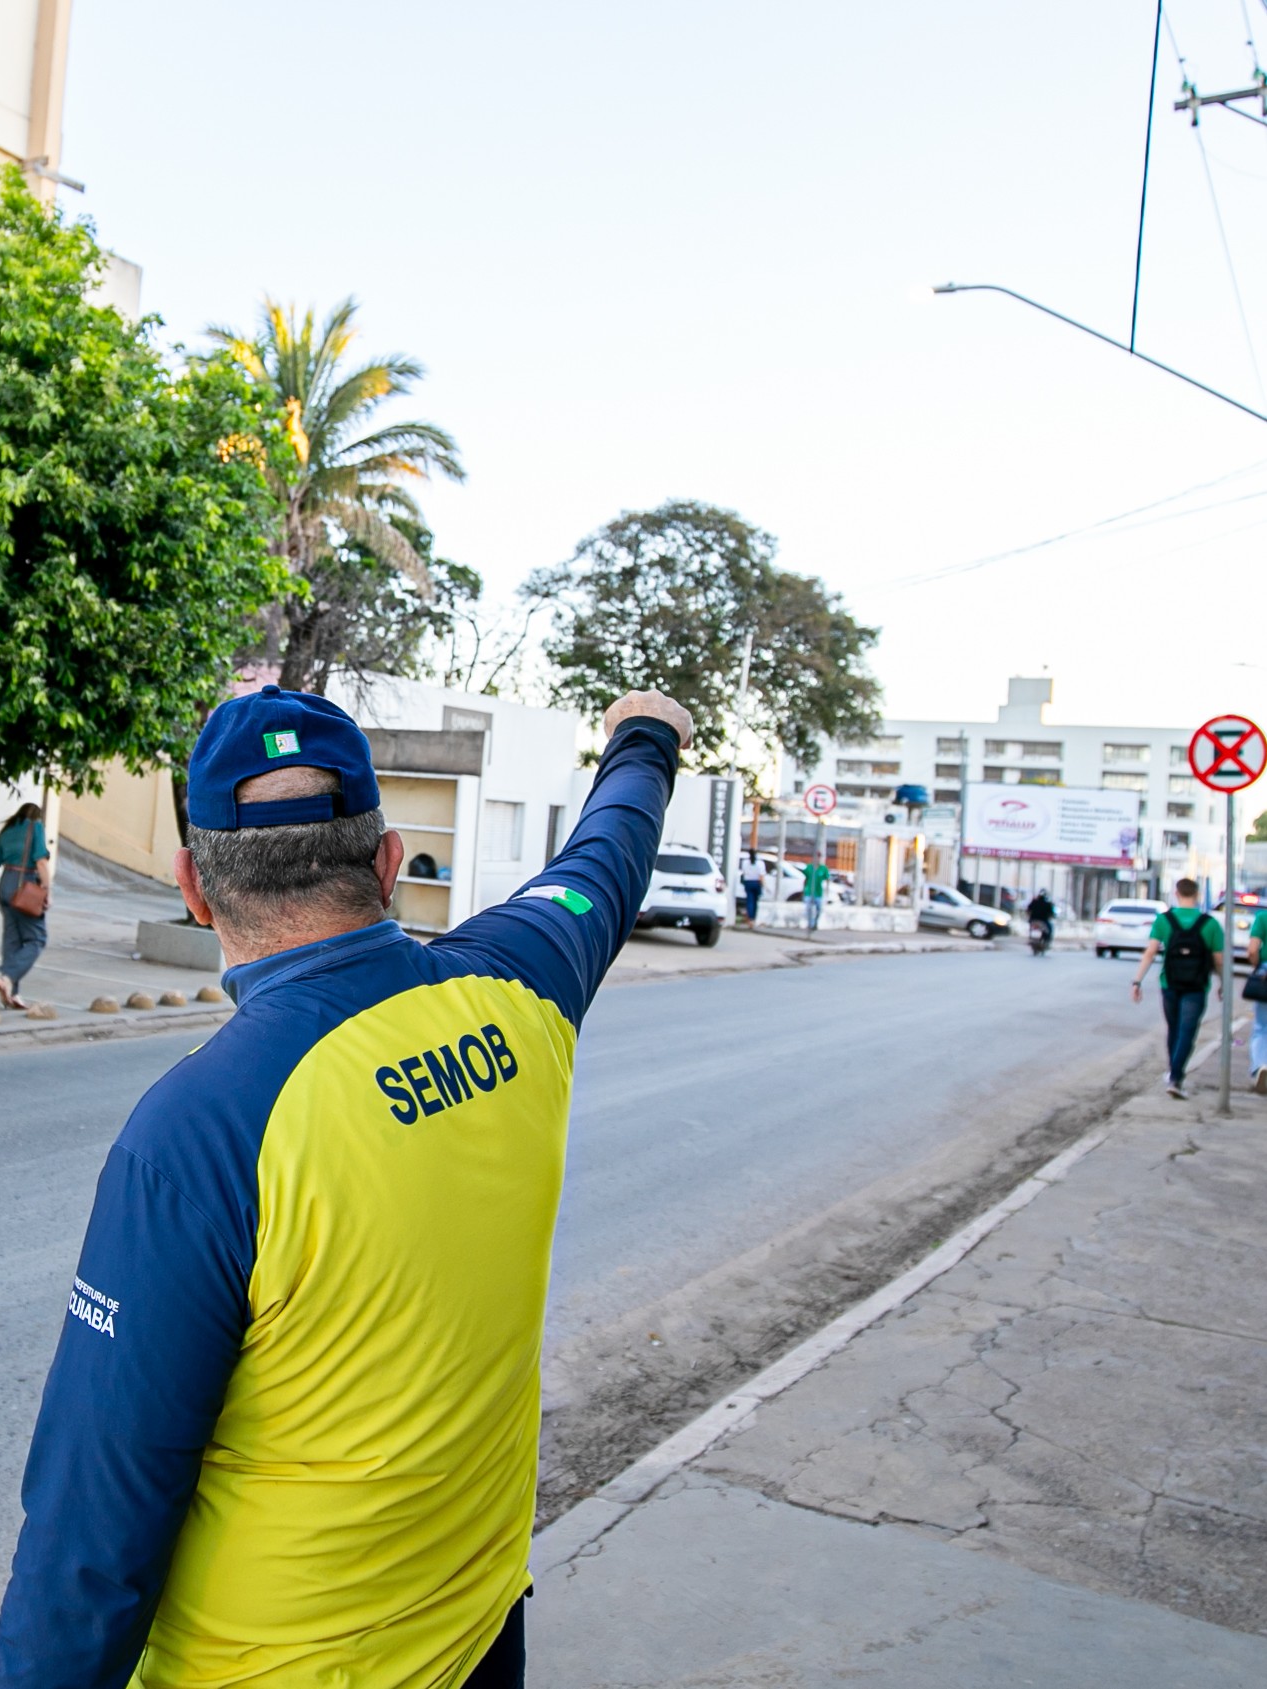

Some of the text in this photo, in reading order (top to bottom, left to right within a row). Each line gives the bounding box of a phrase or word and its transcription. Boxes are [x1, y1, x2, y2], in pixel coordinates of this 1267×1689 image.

[712, 781, 728, 868] RESTAURAN
[375, 1023, 518, 1125] SEMOB
[68, 1290, 115, 1338] CUIABÁ
[107, 1298, 120, 1313] DE
